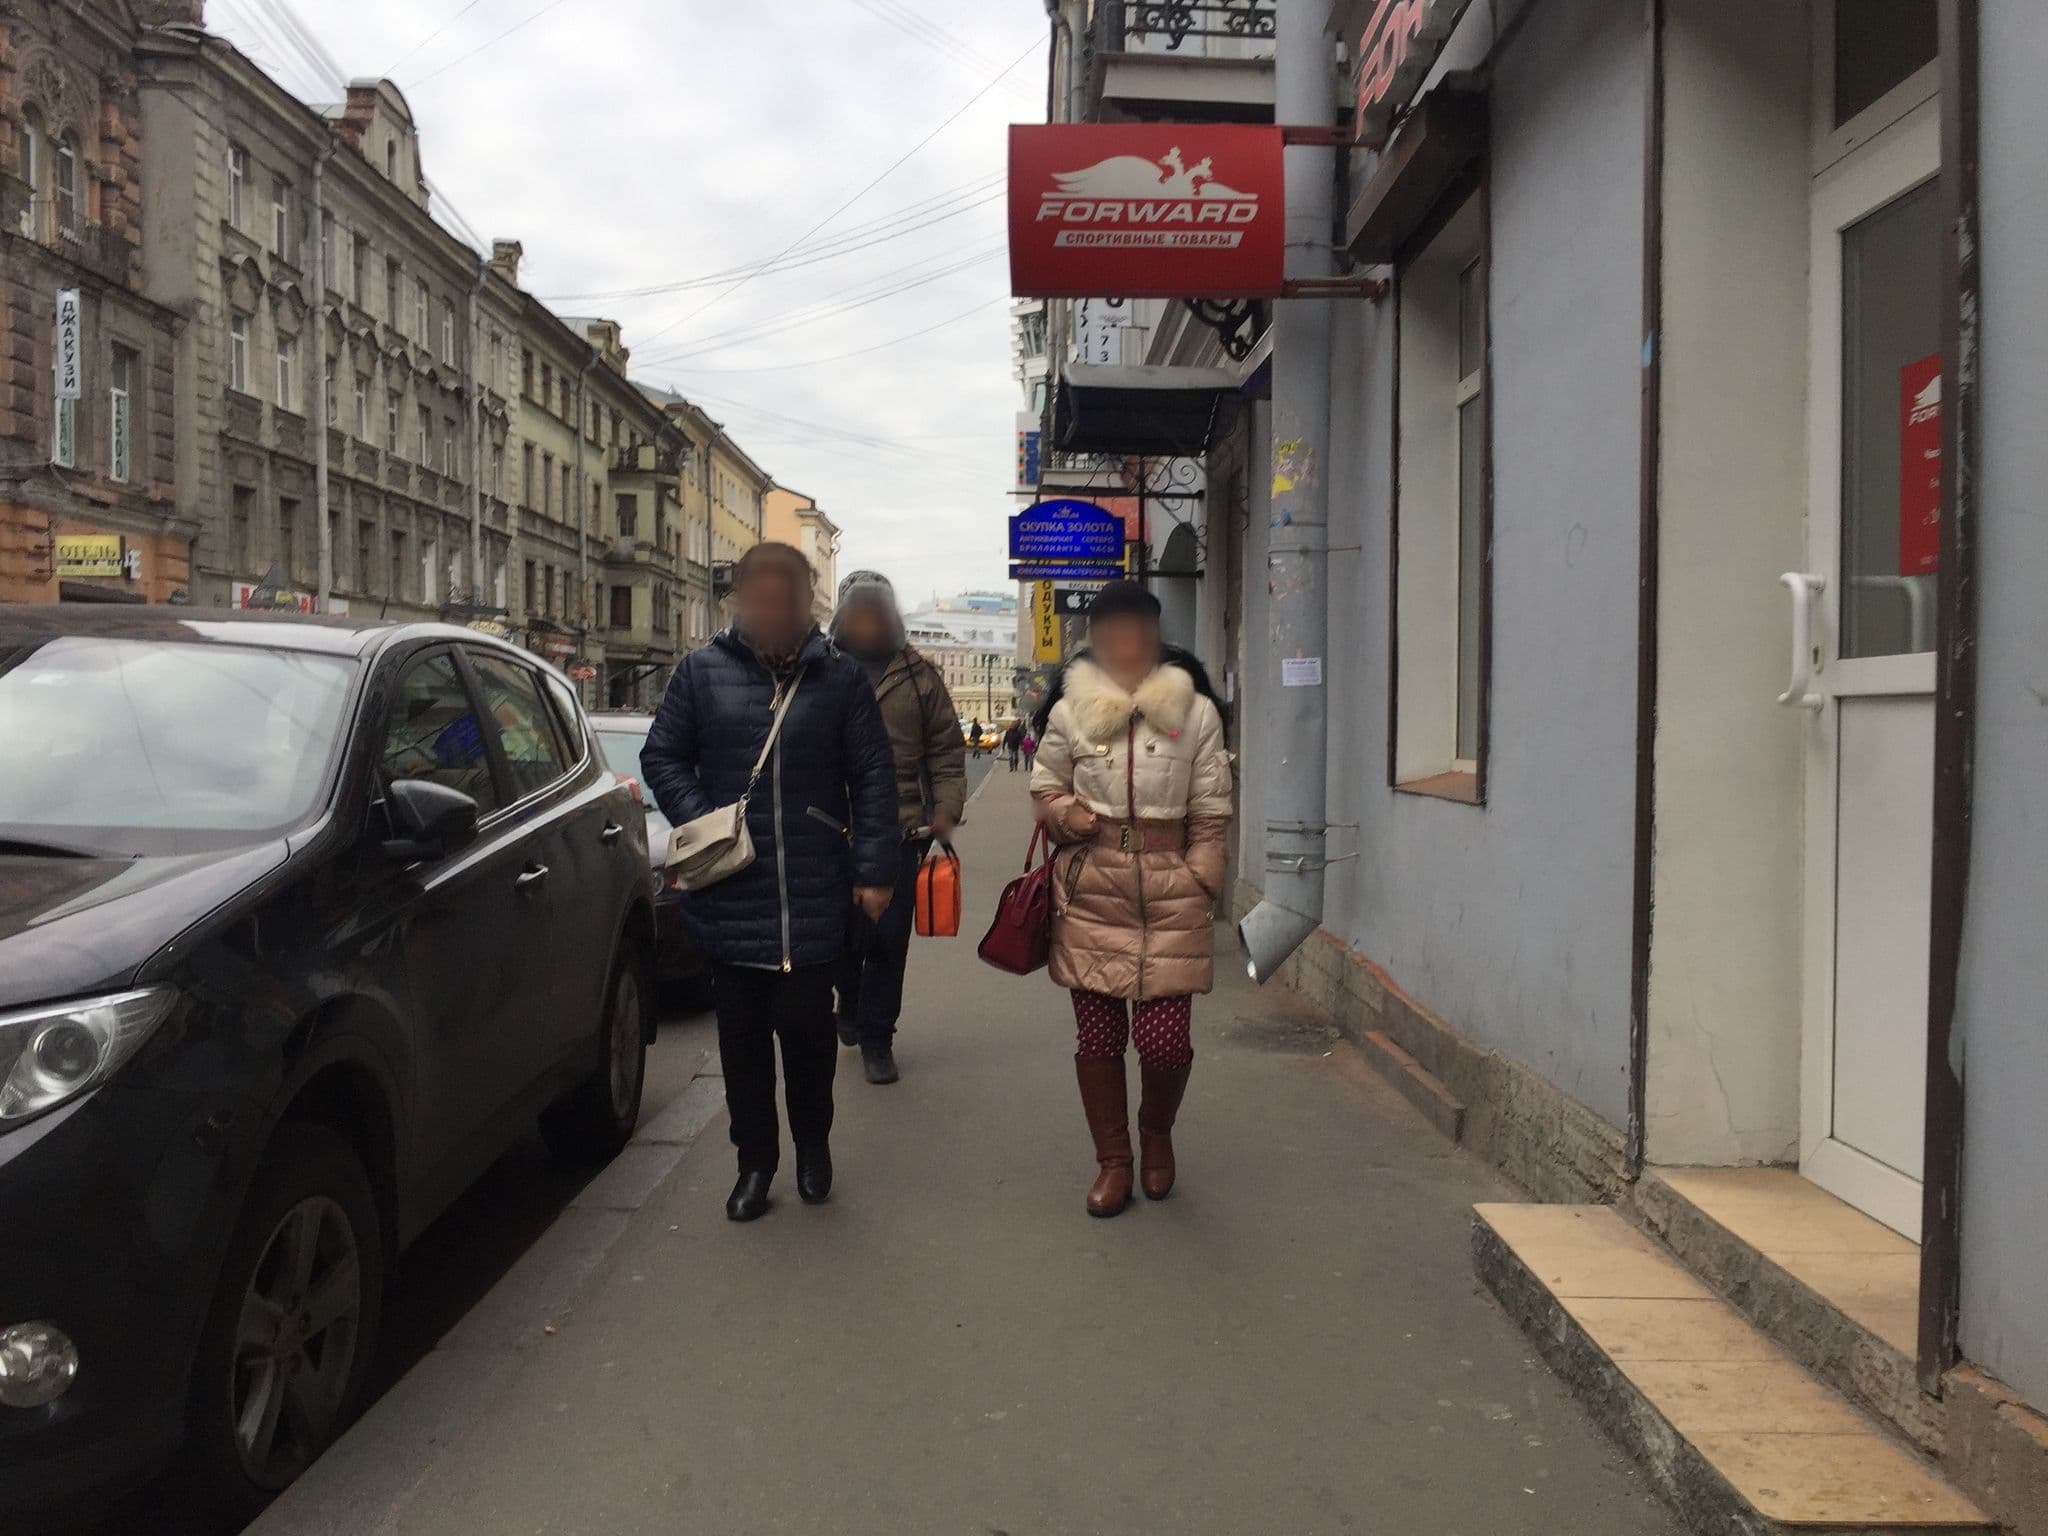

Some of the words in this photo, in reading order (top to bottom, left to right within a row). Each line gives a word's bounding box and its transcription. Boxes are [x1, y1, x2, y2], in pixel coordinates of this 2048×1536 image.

[1035, 201, 1259, 224] FORWARD
[1065, 232, 1165, 246] СПОРТИВНЫЕ
[1171, 232, 1232, 246] ТОВАРЫ
[61, 300, 76, 390] ДЖАКУЗИ
[1019, 521, 1065, 532] СКУПКА
[1067, 521, 1114, 532] ЗОЛОТА
[1019, 544, 1081, 553] БРИЛЛИАНТЫ
